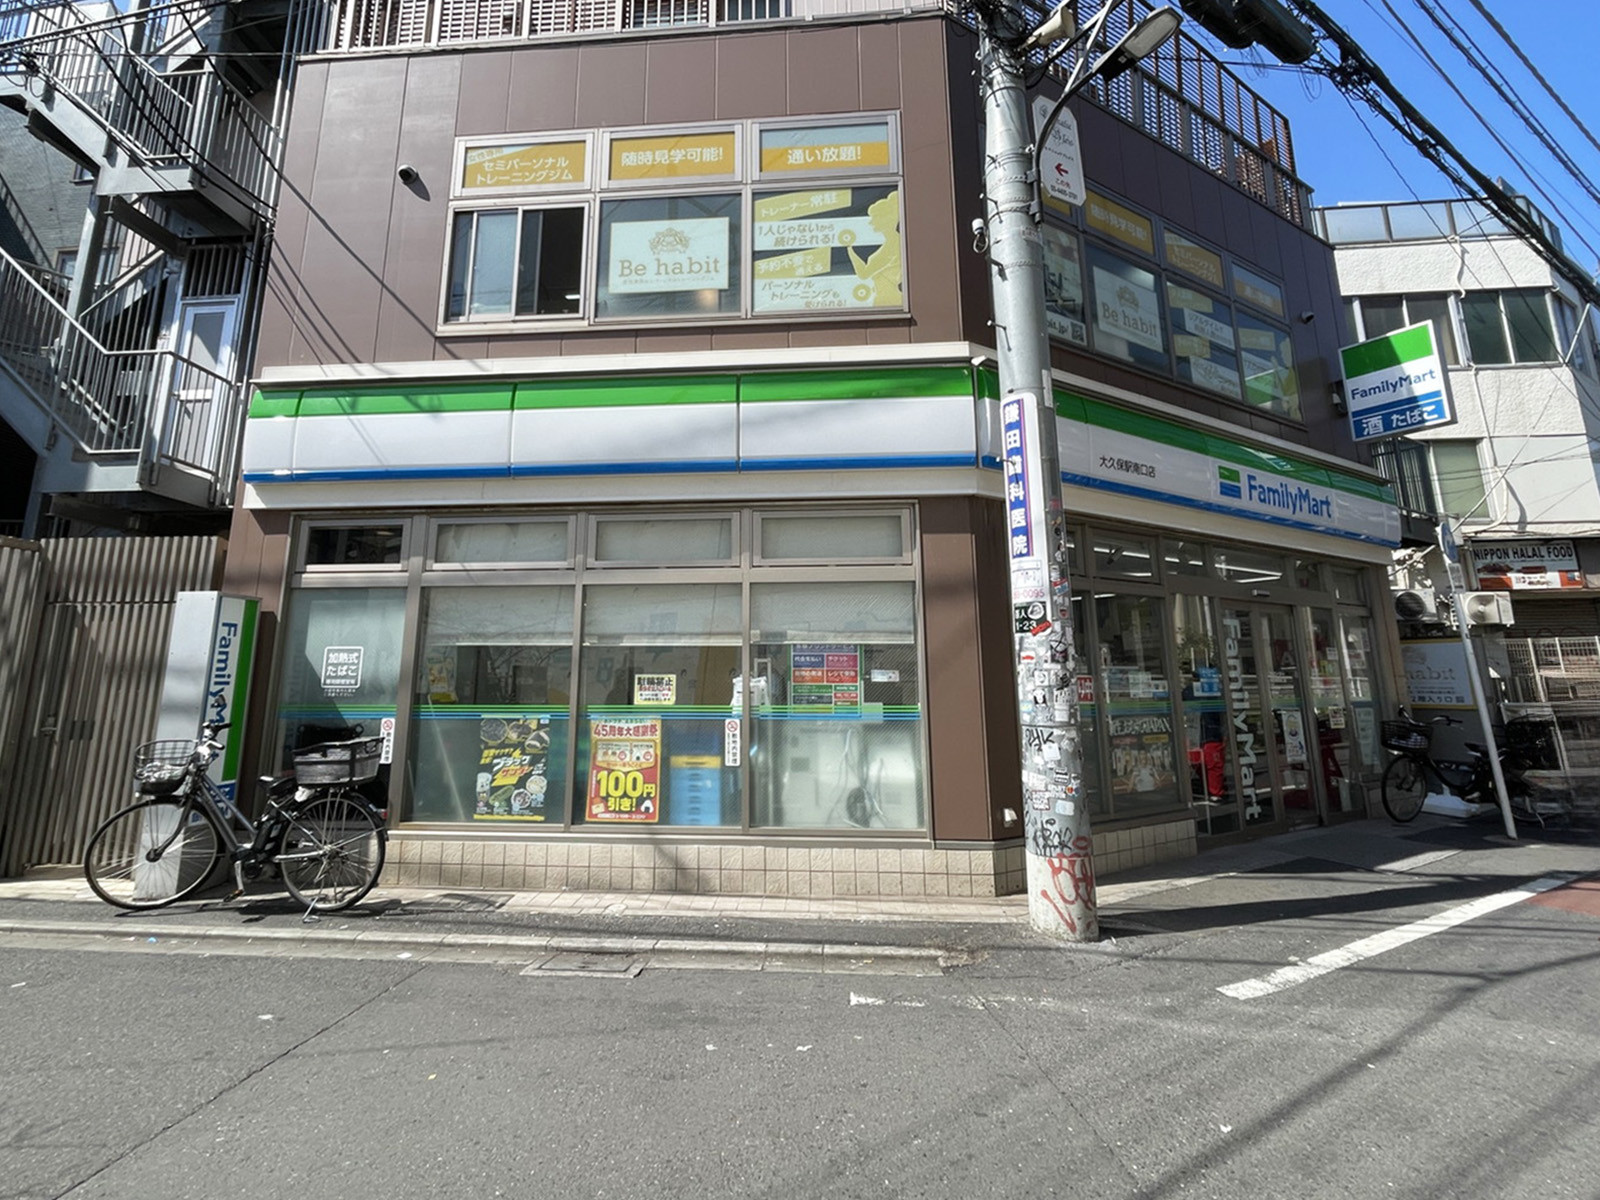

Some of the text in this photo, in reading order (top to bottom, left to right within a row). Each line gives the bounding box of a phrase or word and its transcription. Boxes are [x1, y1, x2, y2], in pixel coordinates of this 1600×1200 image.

[483, 156, 570, 172] セミパーソナル
[621, 146, 724, 167] 随時見学可能!
[787, 146, 862, 165] 通い放題!
[476, 169, 573, 185] トレーニングジム
[618, 256, 720, 278] Be habit
[1101, 302, 1158, 338] Be habit
[1351, 369, 1437, 400] FamilyMart
[1361, 404, 1439, 436] 酒 たばこ
[1099, 455, 1156, 478] 大久保駅南口店
[1247, 474, 1332, 519] FamilyMart
[1474, 545, 1574, 561] NIPPON HALAL FOOD
[327, 652, 359, 664] 加熱式
[326, 666, 358, 676] たばこ
[1222, 617, 1262, 821] FamilyMart
[597, 770, 656, 798] 100円
